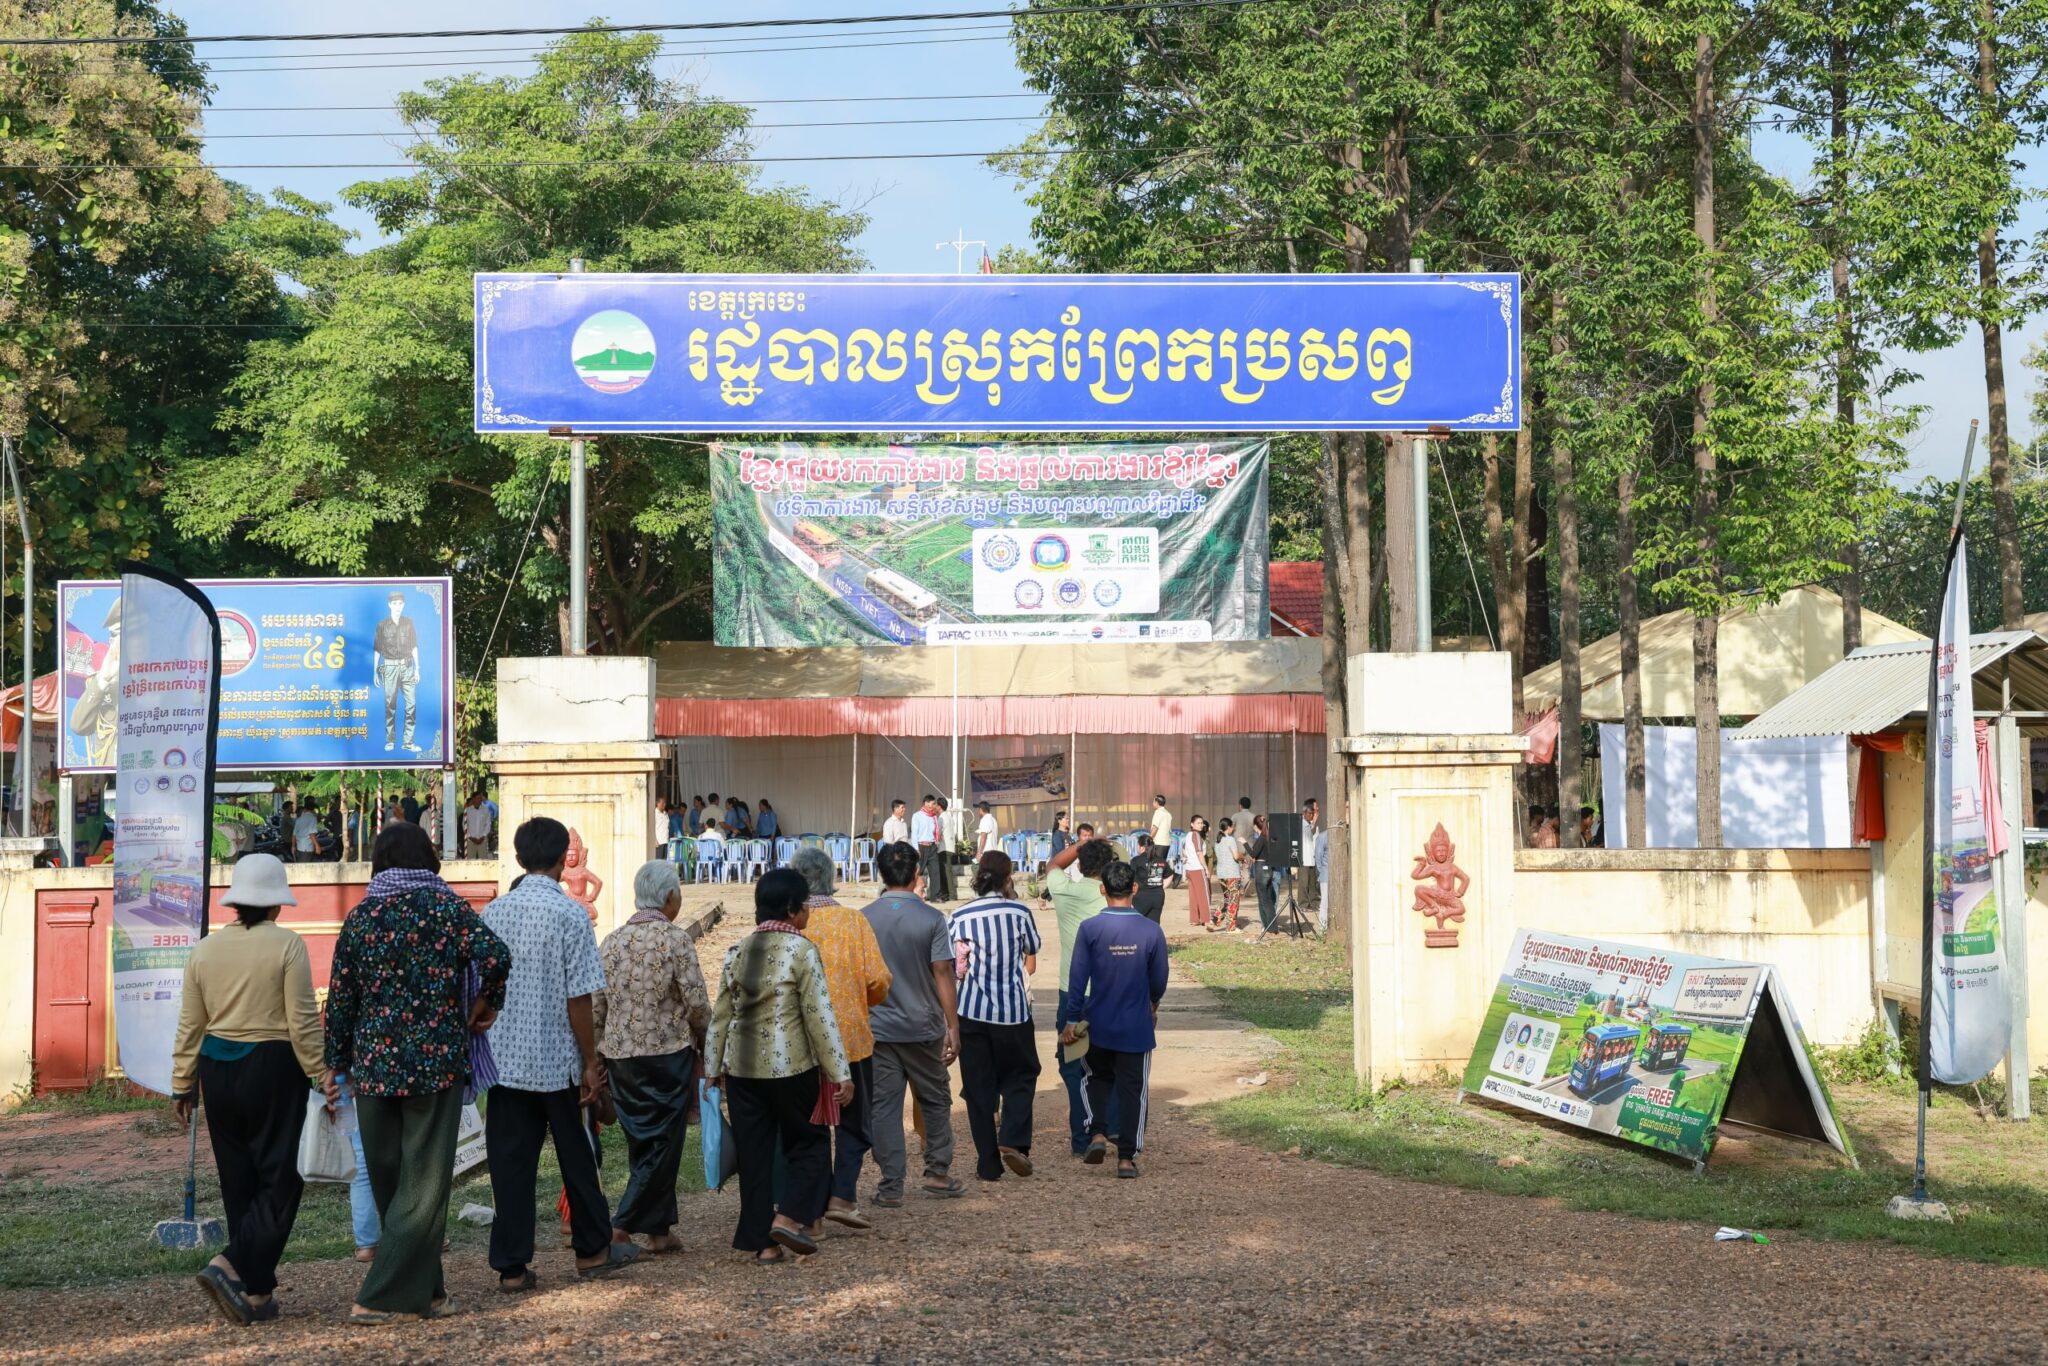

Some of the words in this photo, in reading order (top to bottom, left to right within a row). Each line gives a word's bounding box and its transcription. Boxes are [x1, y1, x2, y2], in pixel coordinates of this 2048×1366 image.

[688, 290, 806, 320] ខេត្តក្រចេះ
[1646, 1086, 1675, 1107] FREE
